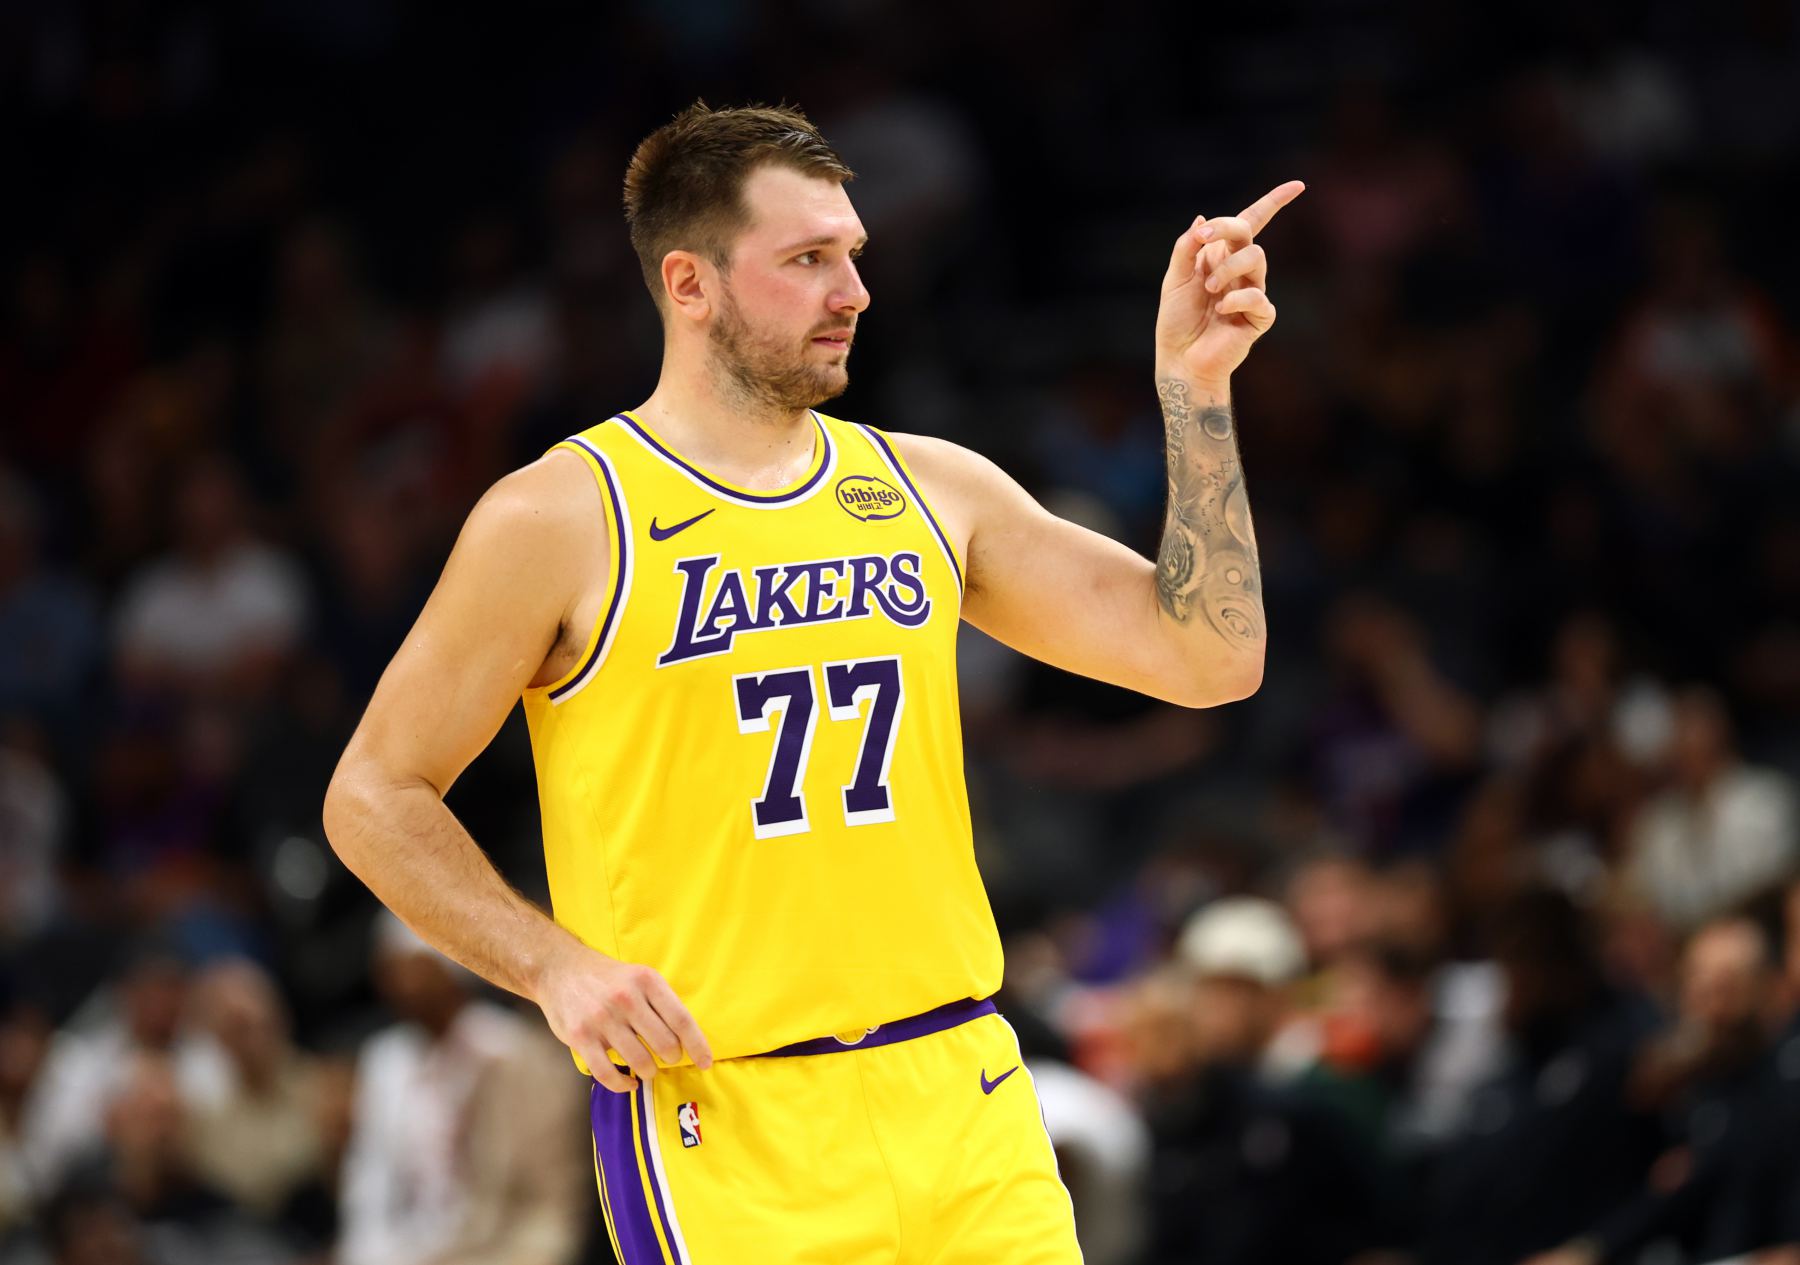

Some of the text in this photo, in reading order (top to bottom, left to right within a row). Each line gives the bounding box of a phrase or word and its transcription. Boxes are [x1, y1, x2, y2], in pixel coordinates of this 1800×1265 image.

[840, 487, 900, 506] bibigo
[856, 502, 883, 512] 비비고
[656, 551, 932, 668] LAKERS
[732, 656, 905, 839] 77
